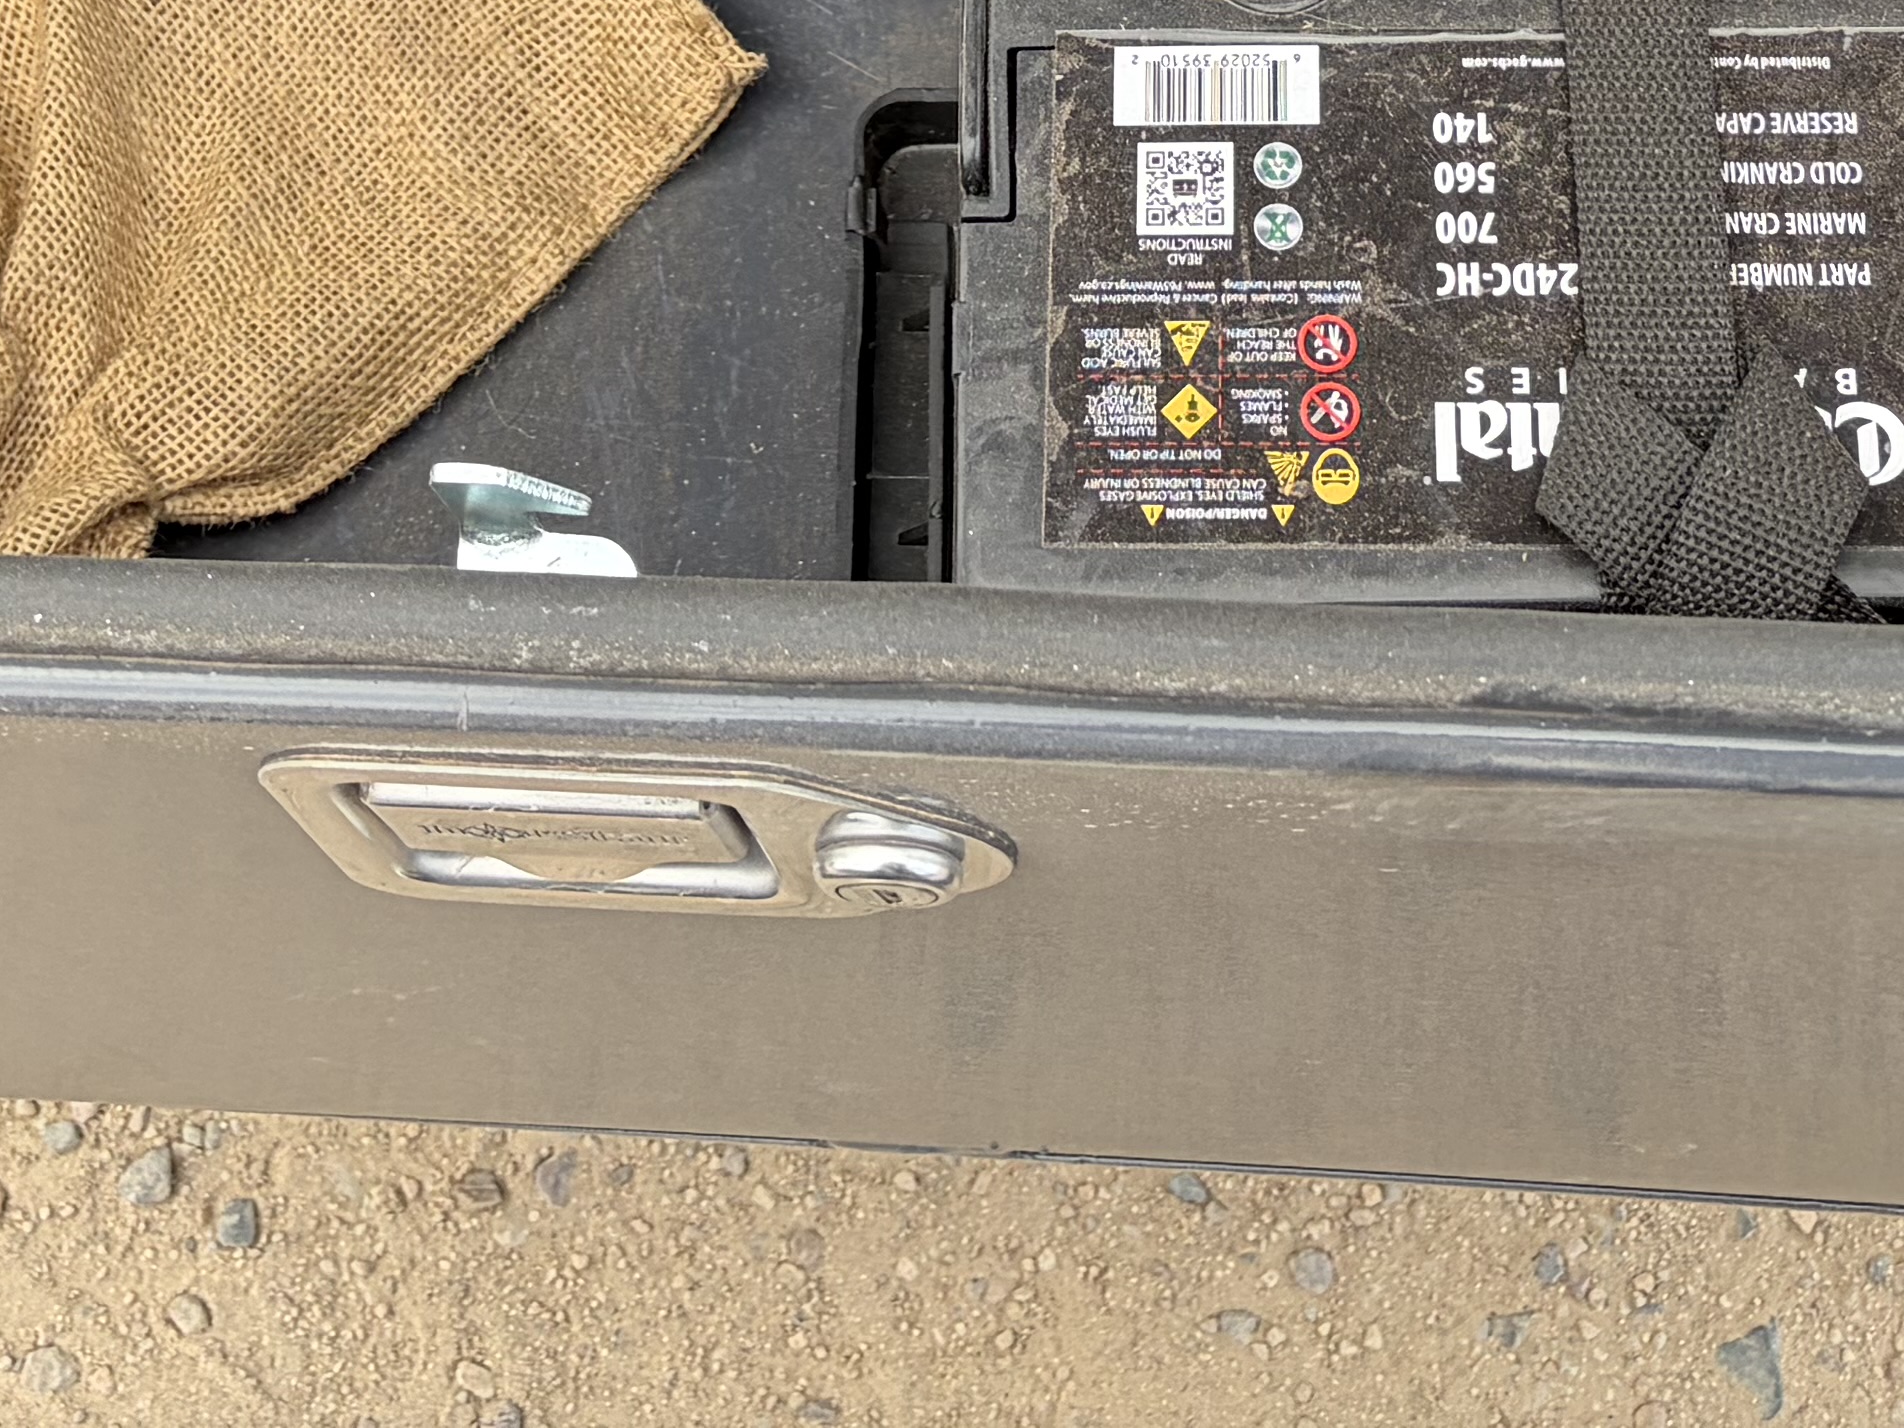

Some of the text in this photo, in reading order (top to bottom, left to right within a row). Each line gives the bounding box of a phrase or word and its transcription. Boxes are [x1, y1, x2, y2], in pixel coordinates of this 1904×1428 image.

[1131, 53, 1300, 67] 6 52029 39510 2
[1462, 56, 1565, 69] www.gocbs.com
[1743, 55, 1759, 70] by
[1762, 57, 1830, 70] Distributed
[1433, 113, 1492, 143] 140
[1770, 112, 1857, 134] RESERVE
[1435, 162, 1496, 192] 560
[1810, 161, 1862, 184] COLD
[1436, 212, 1496, 243] 700
[1725, 212, 1866, 234] MARINE CRAN
[1138, 238, 1232, 251] INSTRUCTIONS
[1167, 253, 1203, 266] READ
[1436, 263, 1579, 295] 24DC-HC
[1819, 263, 1870, 285] PART
[1273, 279, 1296, 290] after
[1300, 279, 1332, 290] hands
[1334, 279, 1362, 290] Wash
[1069, 293, 1099, 304] harm.
[1101, 293, 1170, 304] Reproductive
[1182, 293, 1217, 304] Cancer
[1221, 293, 1247, 304] lead)
[1251, 293, 1298, 304] (Contains
[1307, 293, 1362, 304] WARNING:
[1281, 328, 1296, 338] OF
[1237, 340, 1296, 349] THE REACH
[1245, 351, 1268, 361] OUT
[1270, 351, 1296, 361] KEEP
[1231, 388, 1282, 398] SMOKING
[1240, 401, 1282, 410] FLAMES
[1242, 414, 1282, 423] SPARKS
[1094, 426, 1157, 436] FLUSH EYES
[1270, 426, 1287, 435] NO
[1108, 449, 1221, 460] DO NOT TIP OR OPEN.
[1084, 478, 1267, 489] CAN CAUSE BLINDNESS OR INJURY
[1099, 490, 1134, 501] GASES
[1136, 490, 1193, 501] EXPLOSIVE
[1225, 490, 1264, 501] SHIELD
[1166, 508, 1267, 519] DANGER/POISON
